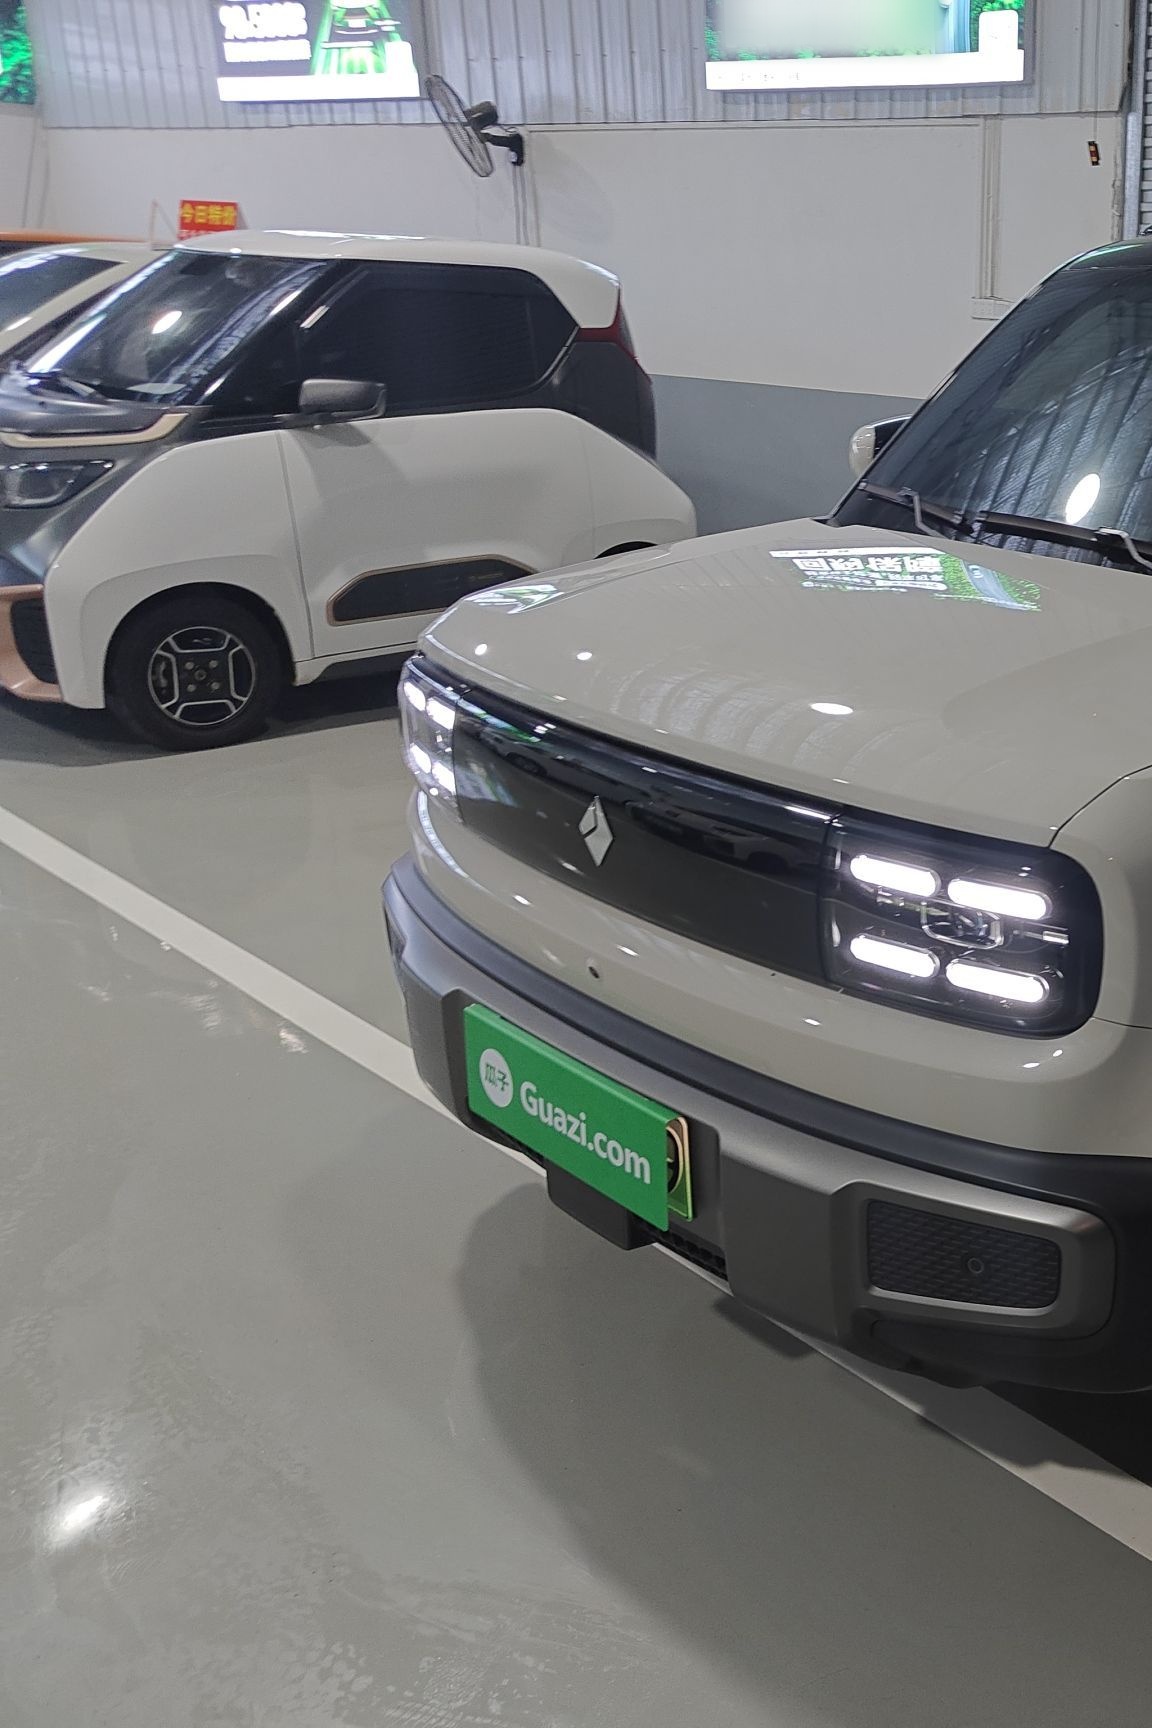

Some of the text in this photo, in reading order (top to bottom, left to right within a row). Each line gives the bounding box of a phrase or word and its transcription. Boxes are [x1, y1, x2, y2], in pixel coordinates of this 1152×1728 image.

[181, 203, 236, 225] 今日特价
[485, 1062, 509, 1091] 瓜子
[520, 1081, 651, 1185] Guazi.com
